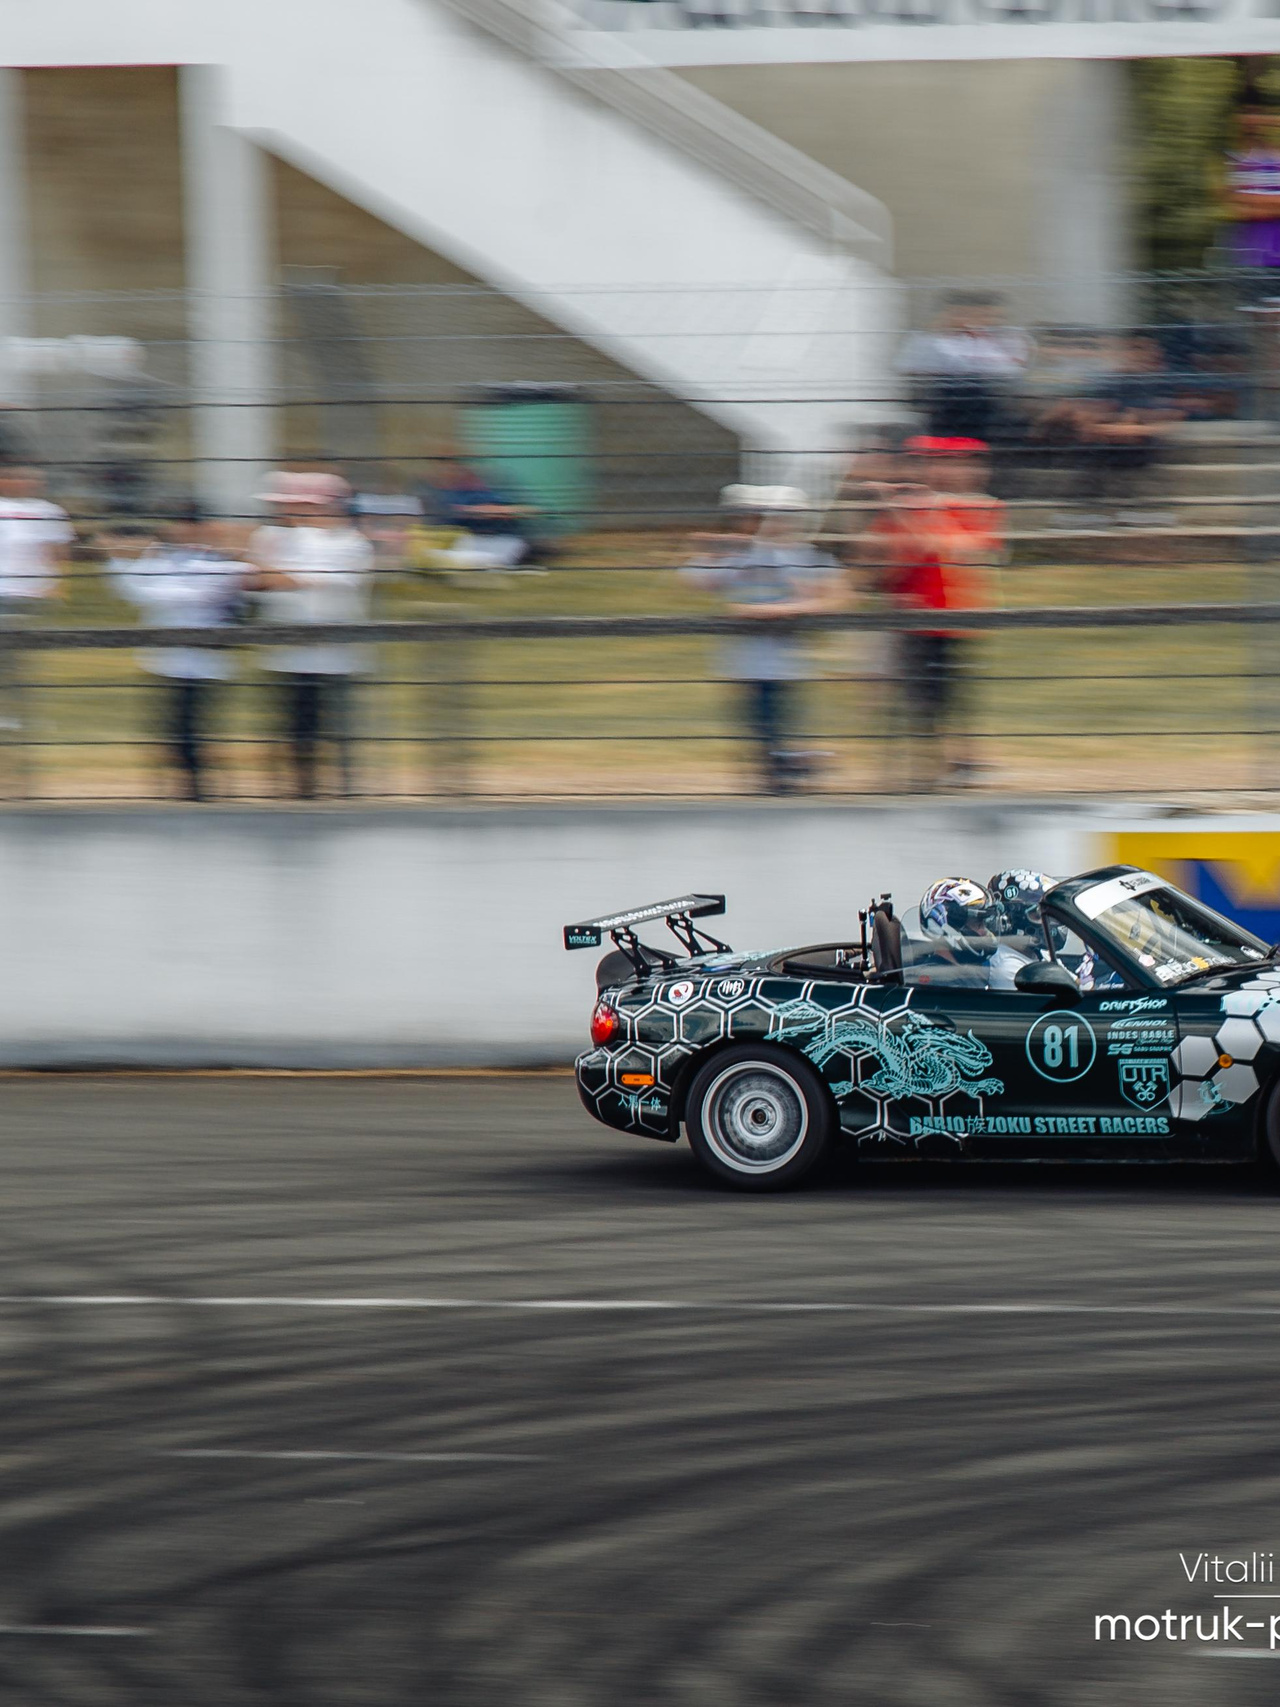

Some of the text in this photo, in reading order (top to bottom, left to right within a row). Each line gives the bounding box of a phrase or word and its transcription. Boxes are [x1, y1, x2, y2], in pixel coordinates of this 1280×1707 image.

[1099, 996, 1168, 1015] DRIFTSHOP
[1043, 1025, 1079, 1068] 81
[1033, 1117, 1097, 1134] STREET
[1099, 1117, 1170, 1134] RACERS
